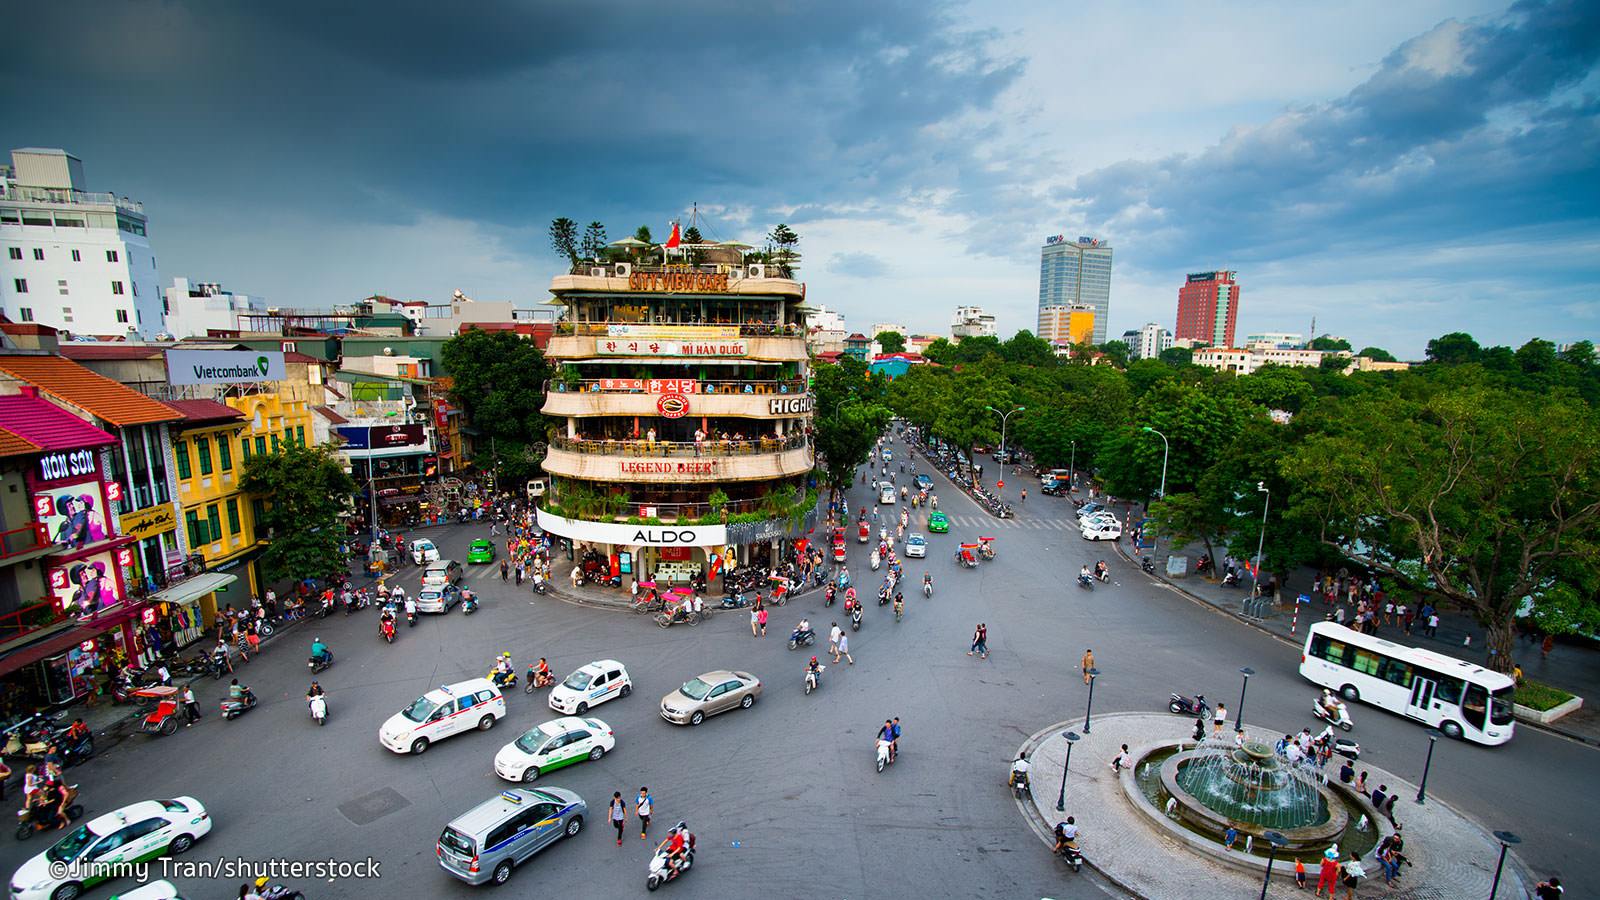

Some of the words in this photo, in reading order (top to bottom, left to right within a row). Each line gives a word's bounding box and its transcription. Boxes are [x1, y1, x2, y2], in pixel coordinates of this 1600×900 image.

[629, 272, 658, 290] CITY
[661, 272, 695, 290] VIEW
[696, 272, 728, 290] CAFE
[719, 341, 744, 354] QUỐC
[193, 364, 259, 379] Vietcombank
[650, 379, 694, 393] 한식당
[40, 452, 70, 480] NÓN
[69, 449, 95, 475] SƠN
[621, 462, 672, 473] LEGEND
[677, 462, 712, 473] BEER
[633, 530, 696, 543] ALDO
